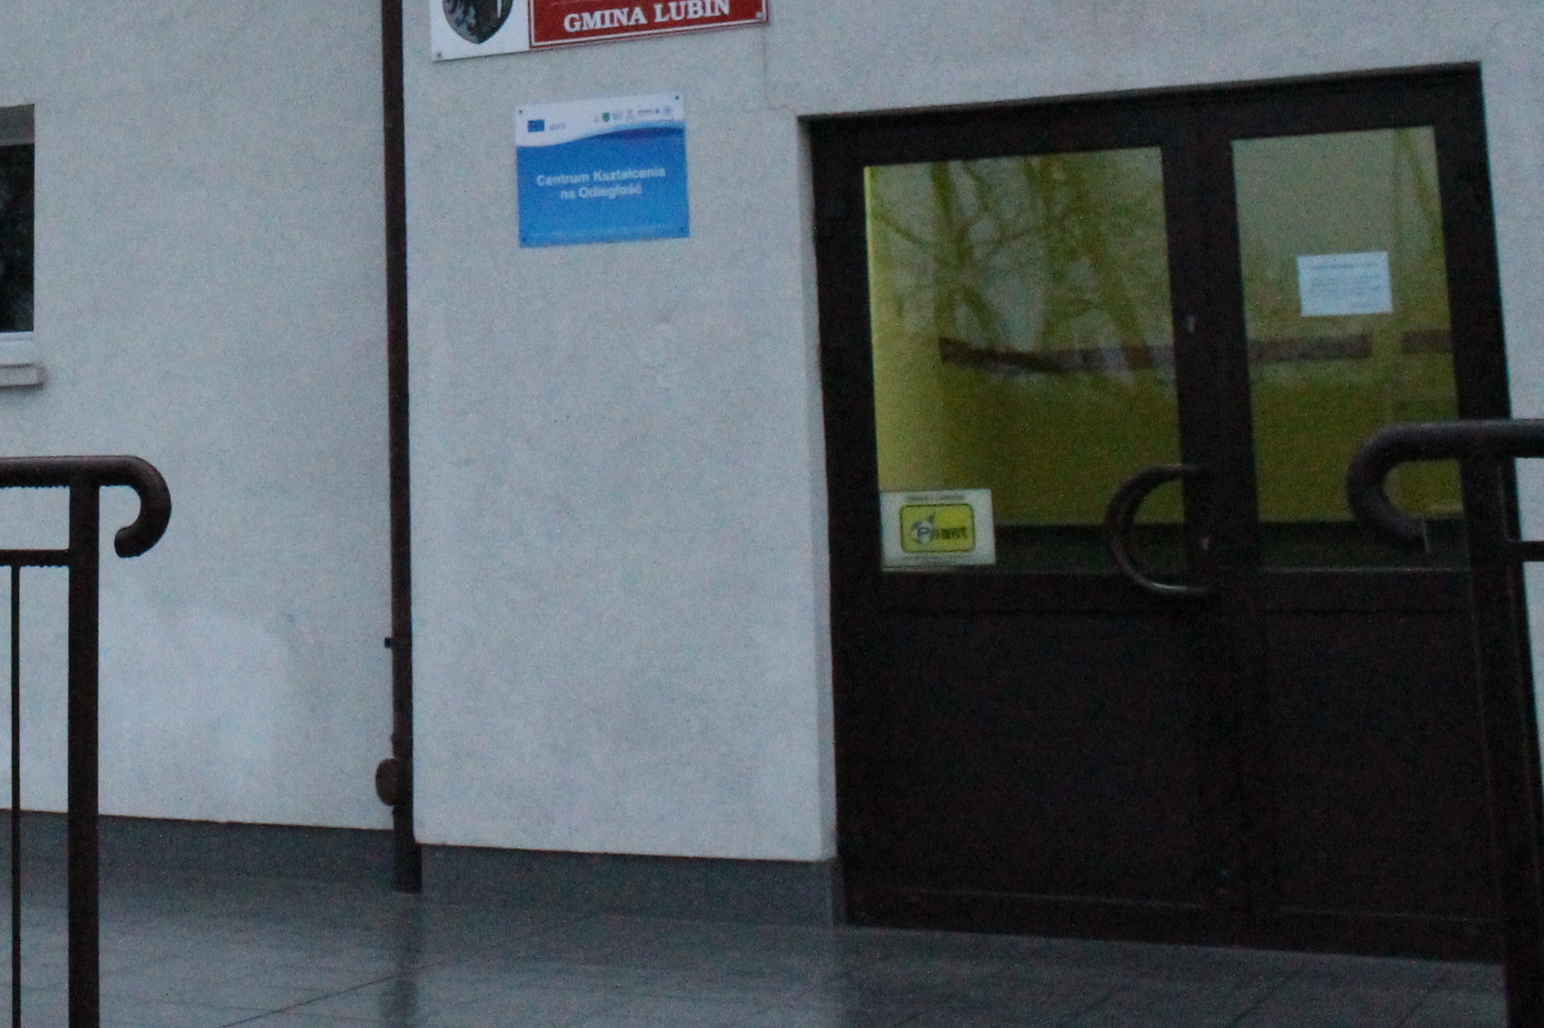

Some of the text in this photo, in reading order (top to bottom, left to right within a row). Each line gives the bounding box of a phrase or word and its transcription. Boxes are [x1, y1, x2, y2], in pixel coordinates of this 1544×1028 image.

[563, 6, 647, 32] GMINA
[536, 166, 666, 187] Centrum Kształcenia
[561, 183, 643, 200] na Odległość
